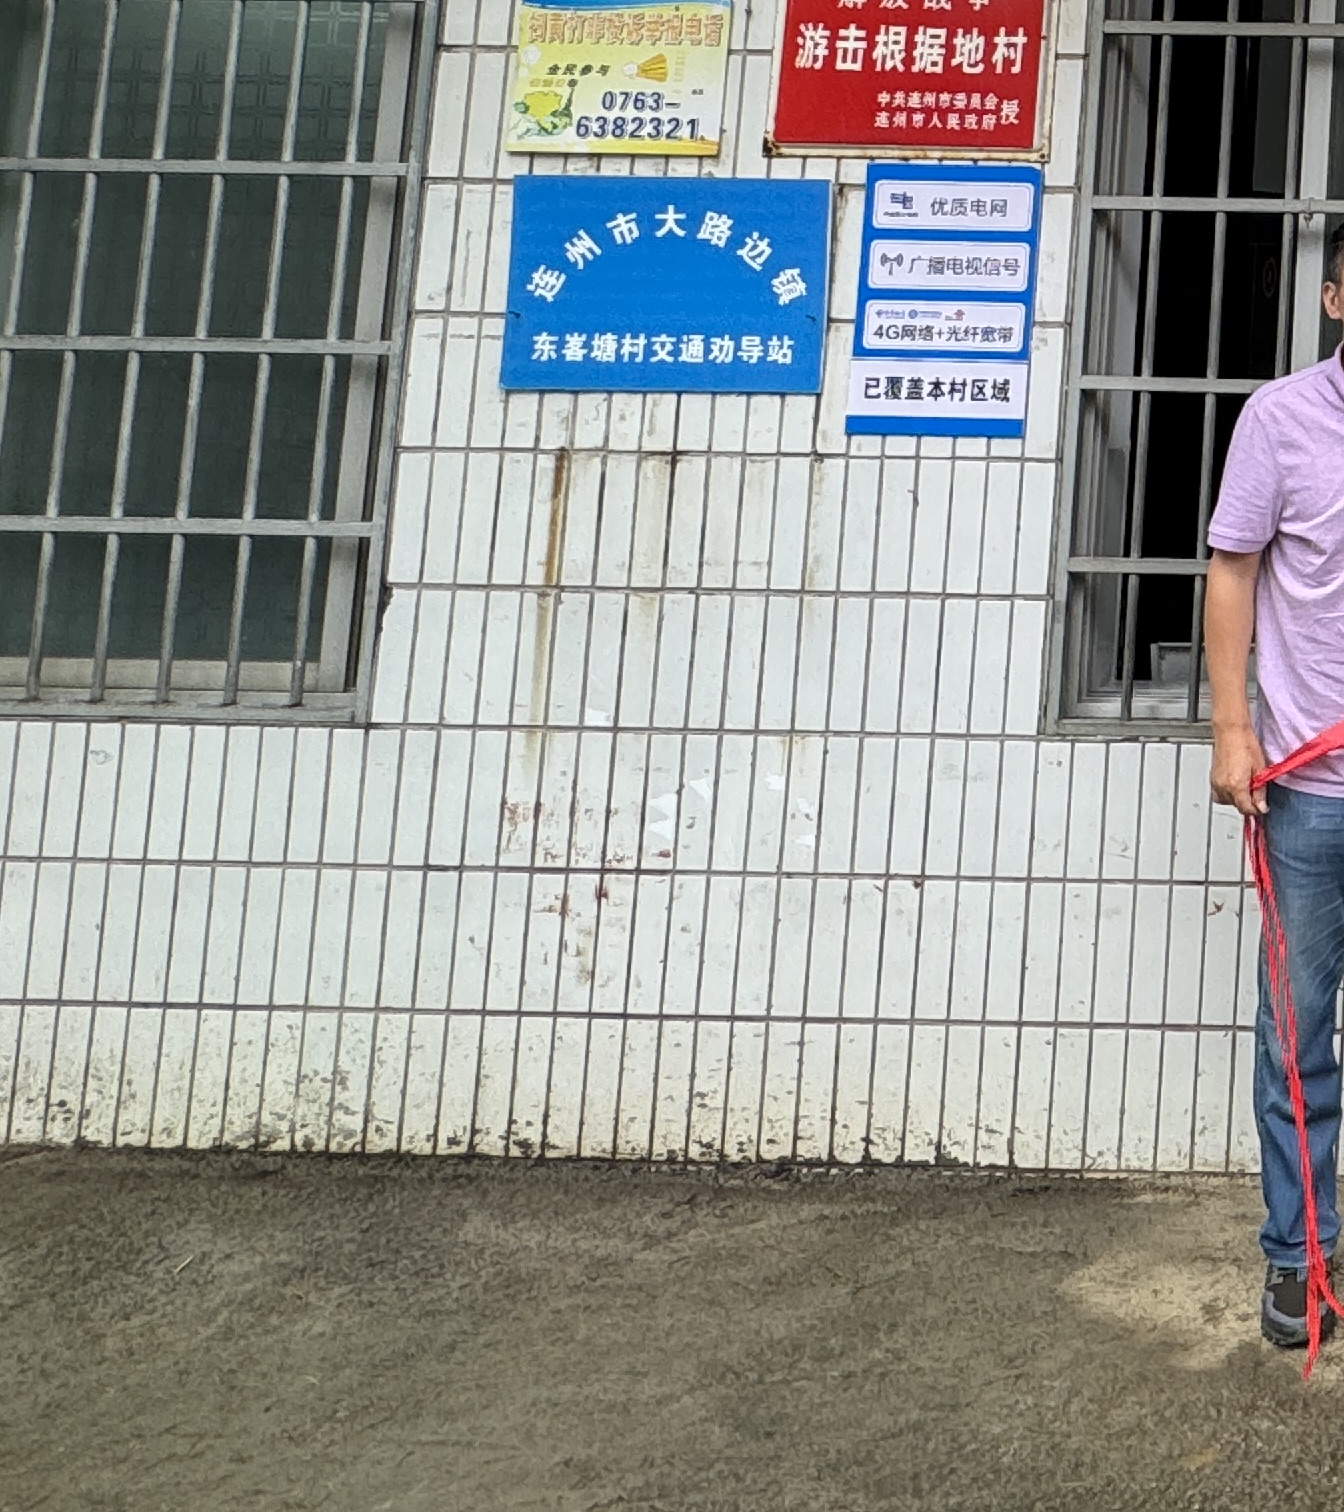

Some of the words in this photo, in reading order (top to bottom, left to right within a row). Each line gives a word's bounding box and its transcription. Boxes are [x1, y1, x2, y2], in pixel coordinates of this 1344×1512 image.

[795, 22, 1028, 75] 游击根据地村
[601, 90, 682, 112] 0763-
[876, 90, 1000, 111] 中共连州市委员会
[873, 110, 998, 132] 连州市人民政府
[999, 98, 1021, 126] 授
[575, 115, 701, 141] 6382321
[930, 196, 1009, 218] 优质电网
[526, 204, 808, 306] 连州市大路边镇
[907, 255, 1022, 277] 广播电视信号
[872, 324, 1015, 344] 4G网络+光纤宽带
[863, 376, 1011, 403] 已覆盖本村区域
